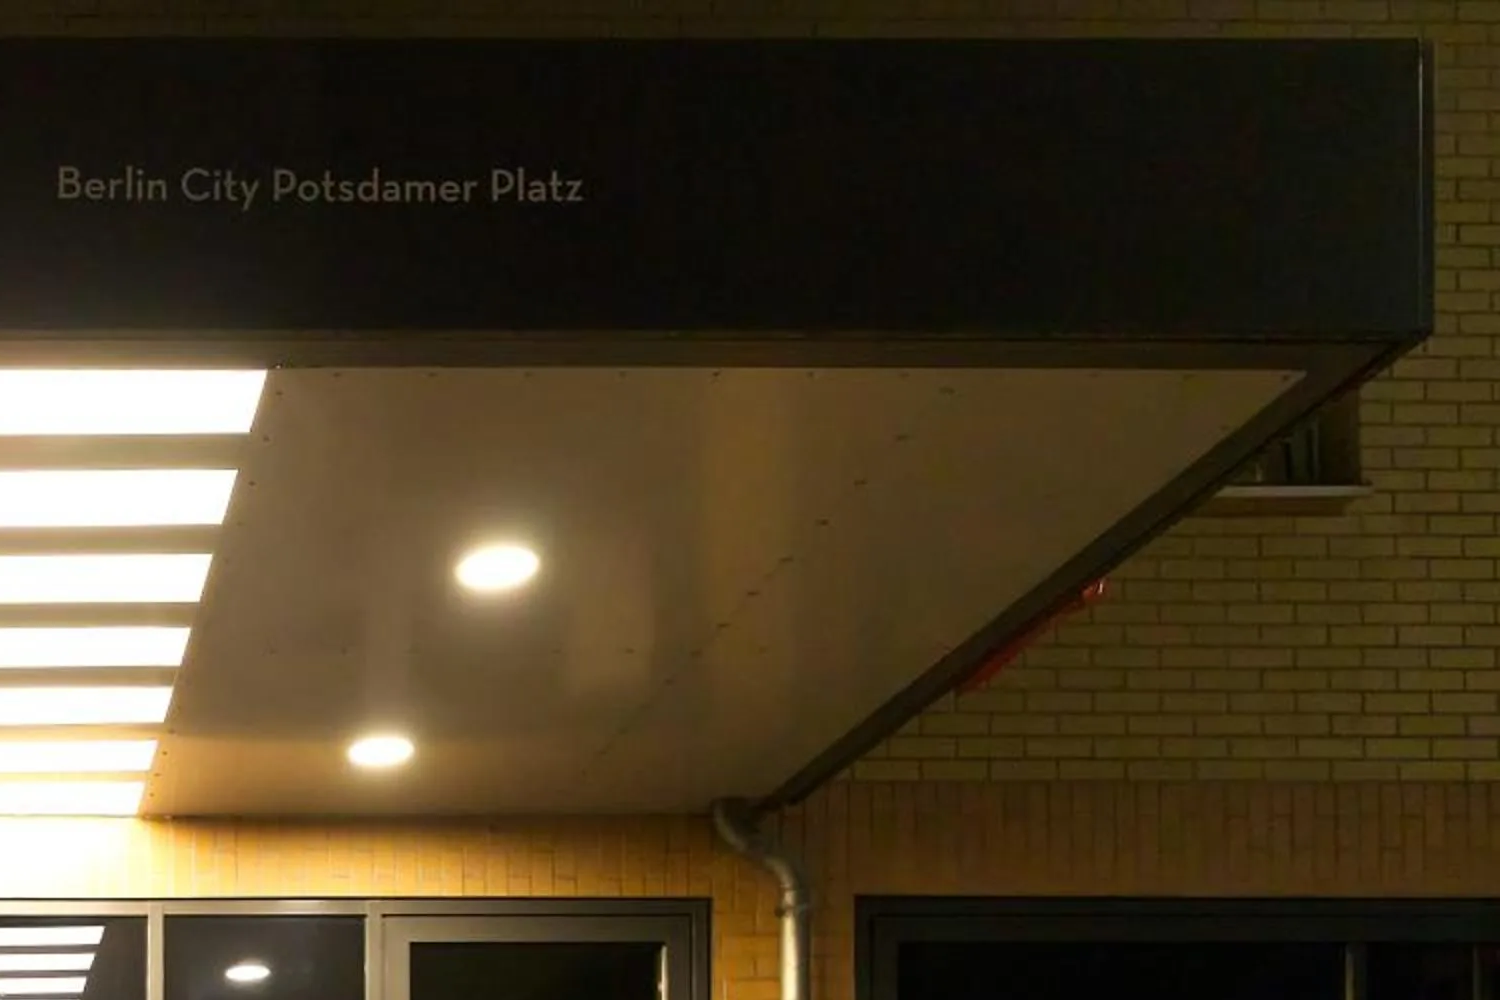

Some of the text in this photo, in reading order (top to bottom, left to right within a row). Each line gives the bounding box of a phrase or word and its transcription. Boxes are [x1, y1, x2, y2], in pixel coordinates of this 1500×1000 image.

[57, 166, 584, 210] Berlin City Potsdamer Platz
